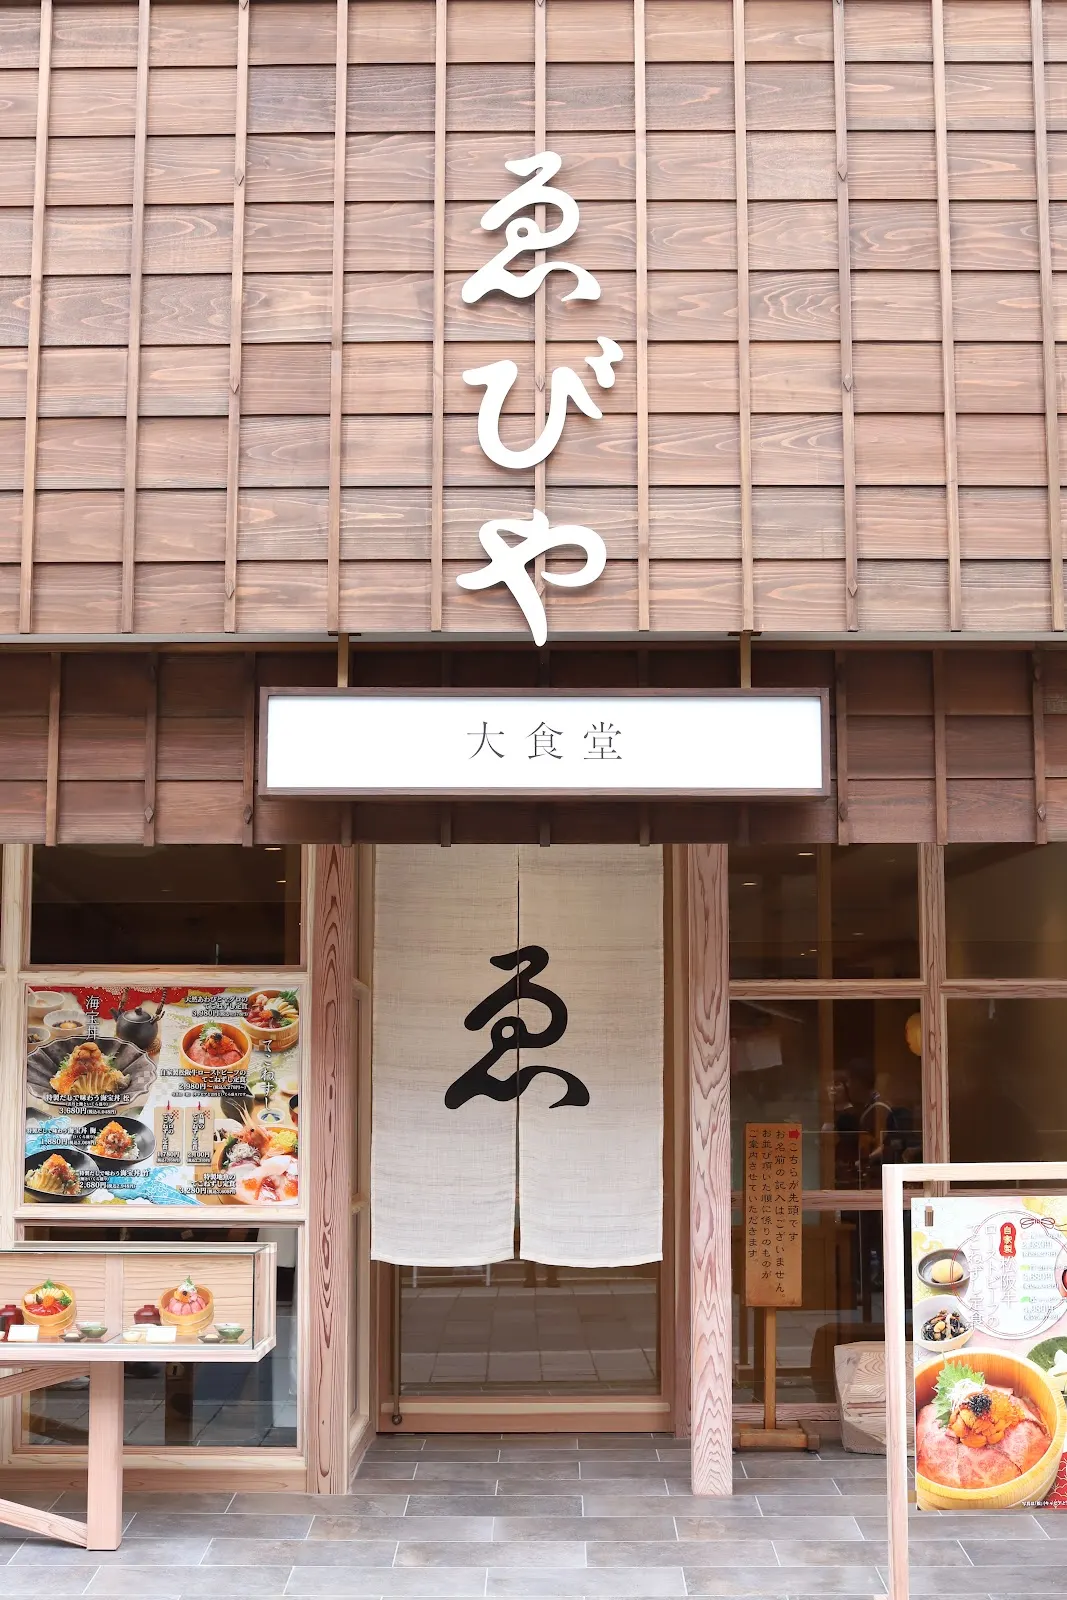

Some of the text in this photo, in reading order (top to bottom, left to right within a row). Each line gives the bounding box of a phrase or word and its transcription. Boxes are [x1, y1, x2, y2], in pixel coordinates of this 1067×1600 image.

[456, 151, 624, 647] ゑびや
[467, 721, 623, 760] 大食堂
[85, 994, 101, 1041] 海宝丼
[445, 945, 590, 1109] ゑ
[747, 1129, 760, 1263] ご案内させていただきます。
[761, 1129, 773, 1279] お並び頂いた順に係りのものが
[774, 1129, 787, 1298] お名前の記入はございません。
[788, 1142, 800, 1242] こちらが先頭です
